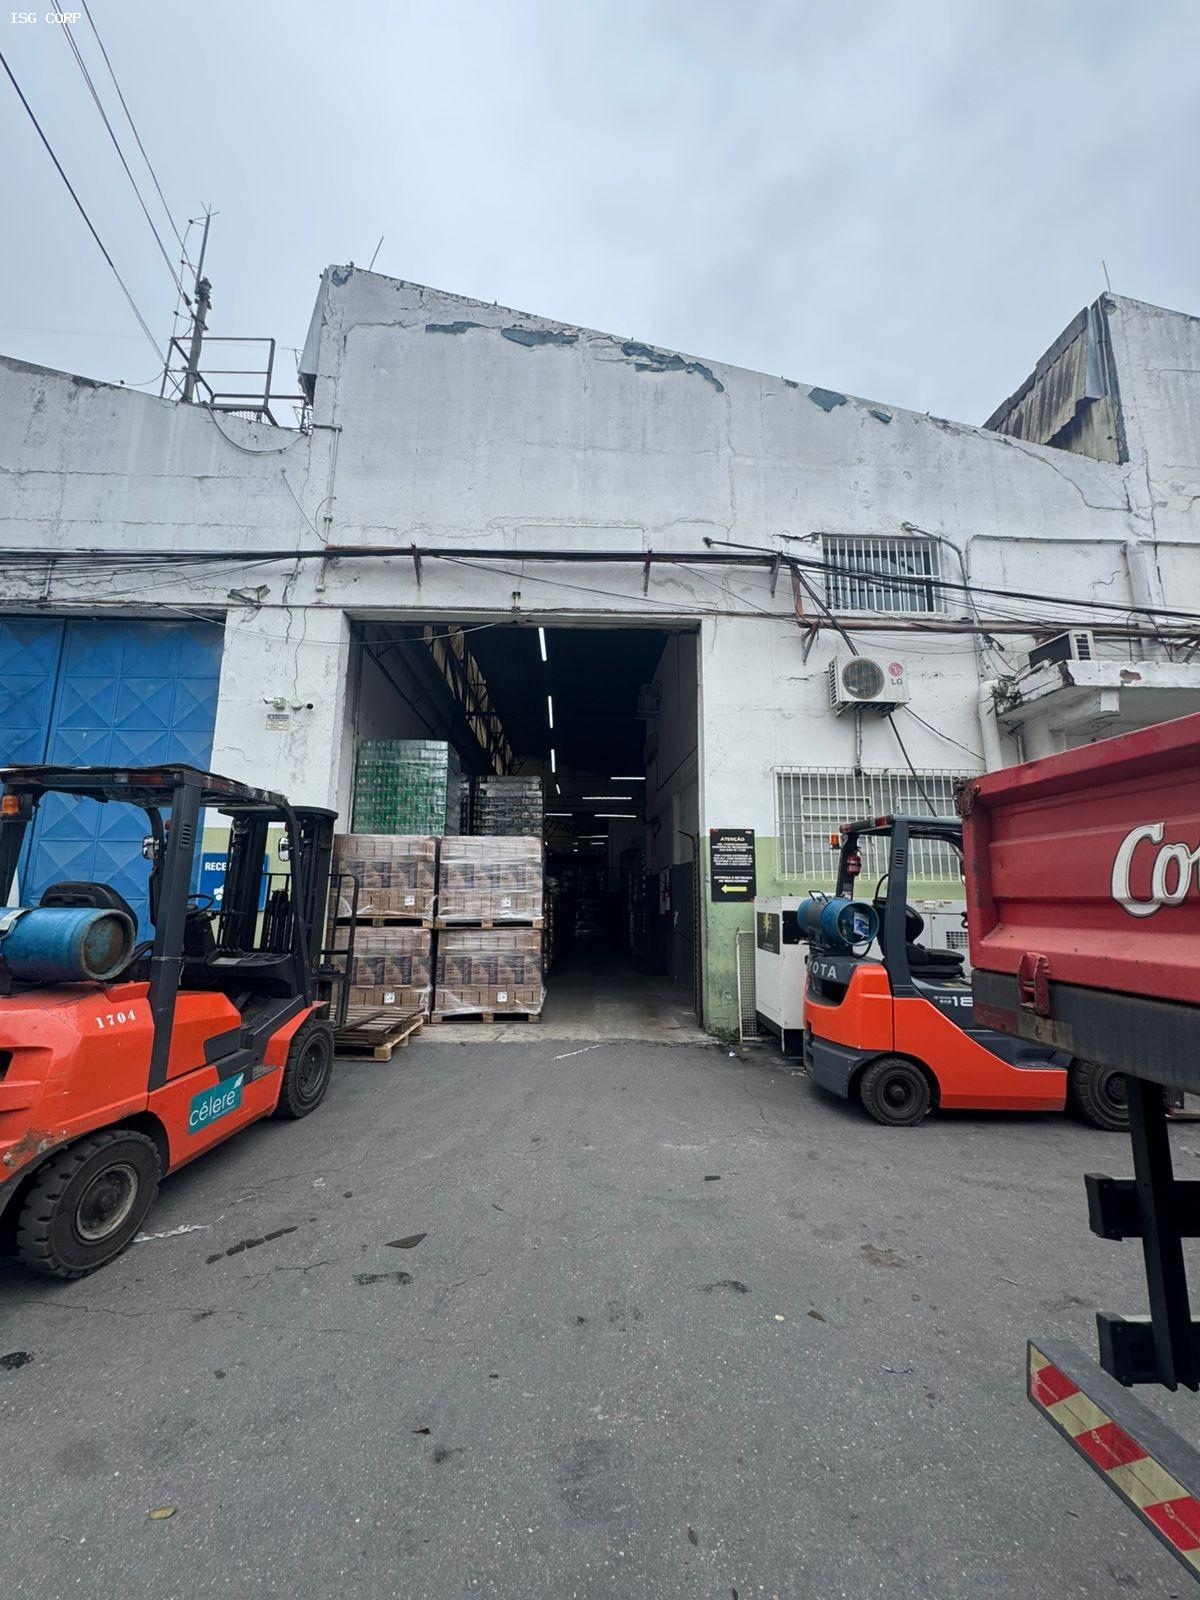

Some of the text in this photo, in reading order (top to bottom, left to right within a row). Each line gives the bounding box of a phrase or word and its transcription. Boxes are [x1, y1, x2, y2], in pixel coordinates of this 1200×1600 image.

[204, 861, 230, 871] RECE
[1111, 821, 1200, 918] Co
[96, 1009, 136, 1029] 1704
[189, 1090, 236, 1126] célere
